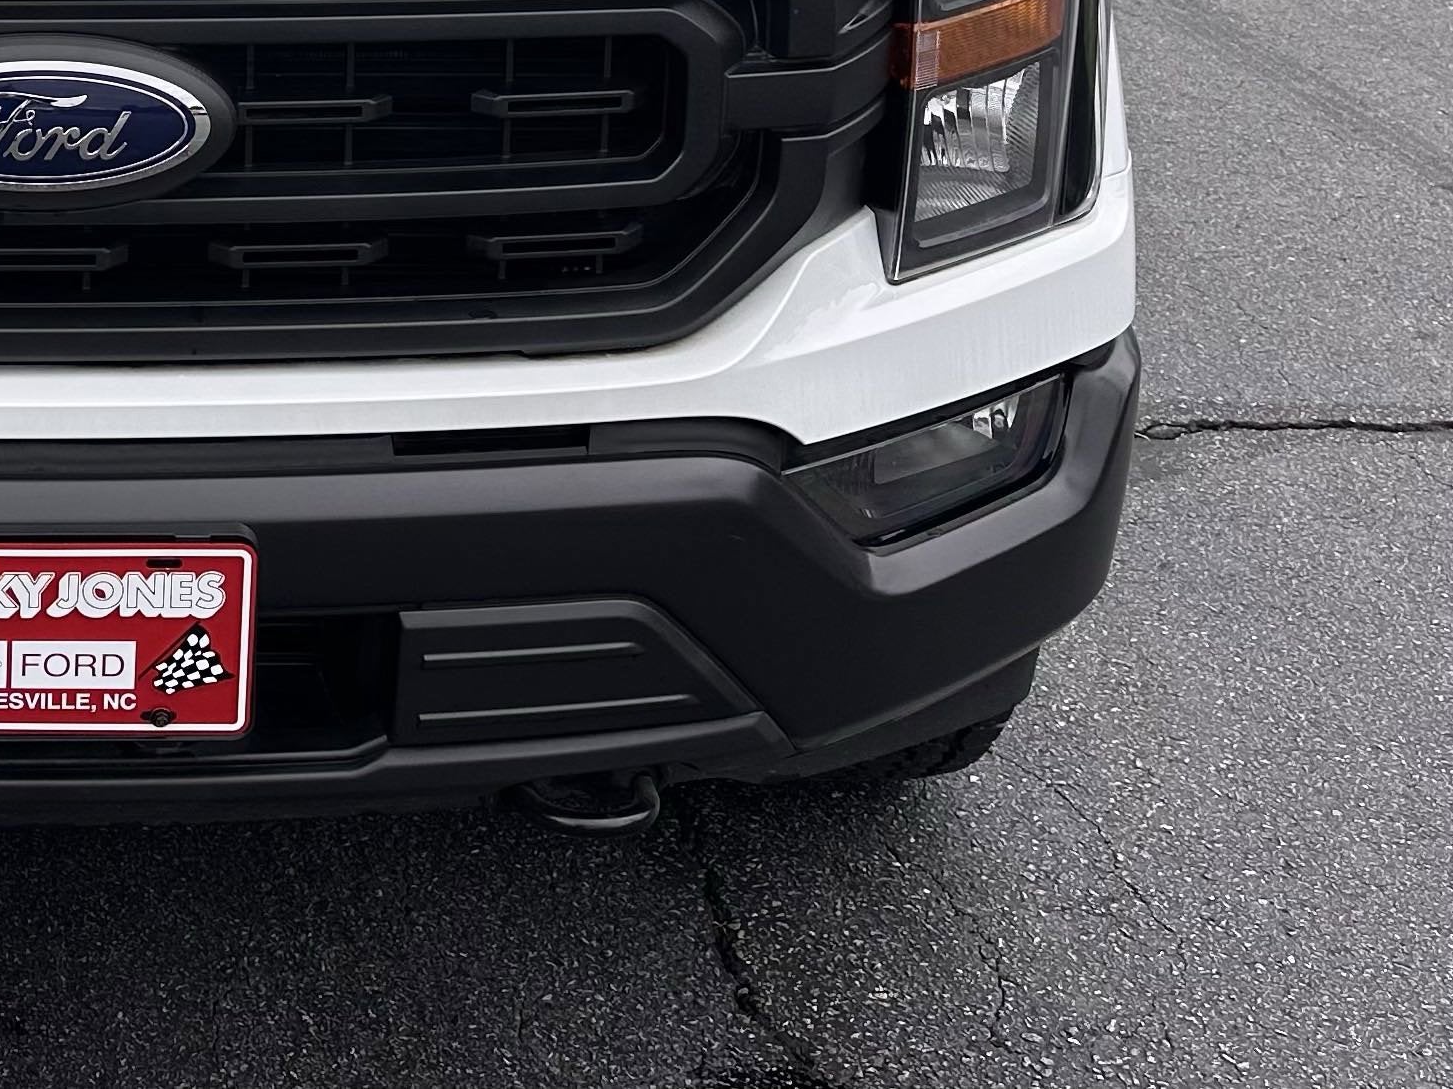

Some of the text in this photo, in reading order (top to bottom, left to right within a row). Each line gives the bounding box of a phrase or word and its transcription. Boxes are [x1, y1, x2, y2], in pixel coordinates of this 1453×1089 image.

[46, 570, 226, 619] JONES
[21, 653, 125, 677] FORD
[103, 692, 137, 710] NC
